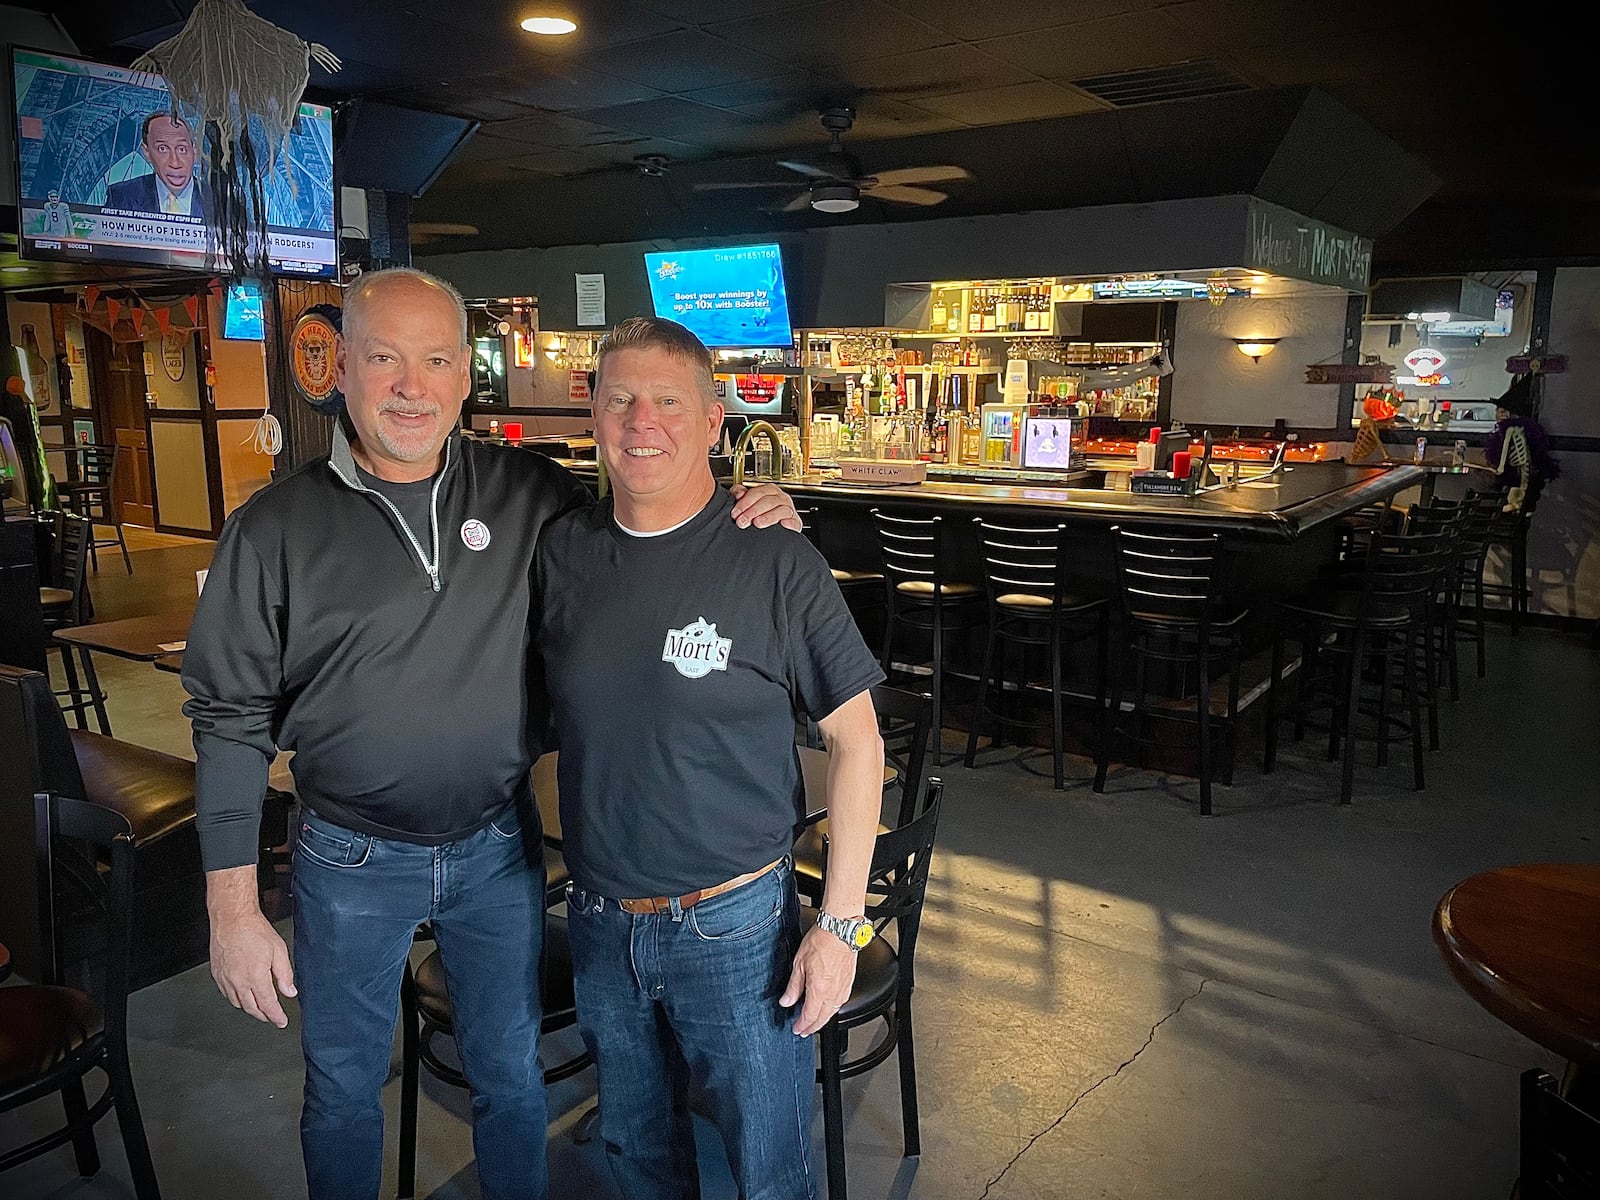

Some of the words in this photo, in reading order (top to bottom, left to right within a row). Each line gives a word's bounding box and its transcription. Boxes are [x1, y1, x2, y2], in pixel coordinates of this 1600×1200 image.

[51, 211, 59, 223] 8
[118, 208, 134, 217] TAKE
[133, 210, 167, 220] PRESENTED
[175, 214, 191, 222] ESPN
[101, 221, 125, 231] HOW
[127, 223, 154, 234] MUCH
[156, 226, 168, 235] OF
[170, 227, 191, 237] JETS
[1252, 212, 1292, 267] Welcome
[714, 253, 736, 262] Draw
[675, 292, 697, 301] Boost
[699, 292, 716, 301] your
[718, 290, 755, 300] winnings
[757, 289, 768, 299] by
[674, 303, 684, 311] up
[685, 302, 694, 310] to
[695, 300, 713, 309] 10x
[715, 301, 733, 309] with
[735, 299, 770, 308] Booster!
[851, 467, 876, 475] WHITE
[878, 468, 900, 476] CLAW
[665, 635, 727, 662] Mort's
